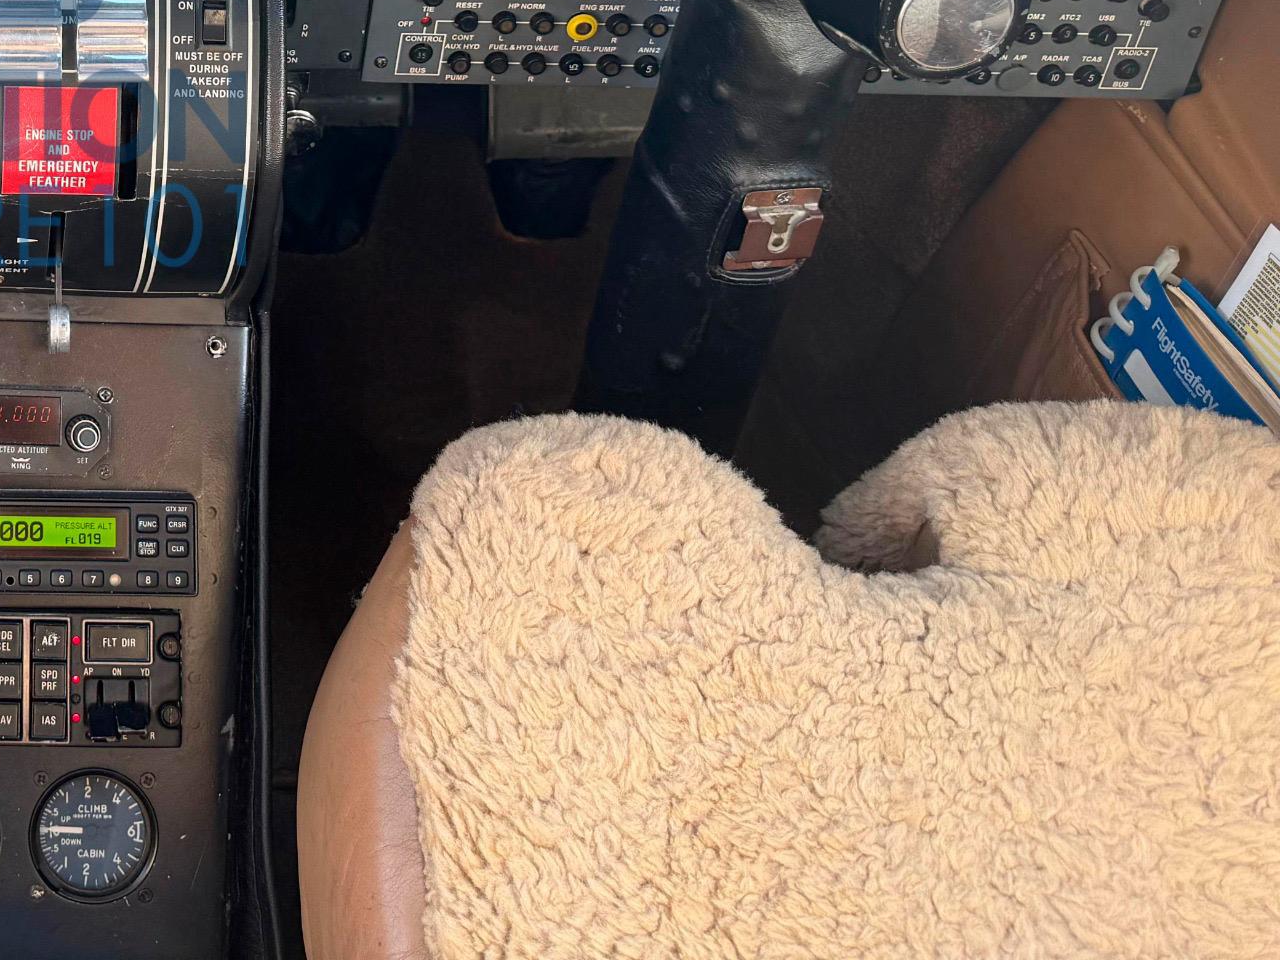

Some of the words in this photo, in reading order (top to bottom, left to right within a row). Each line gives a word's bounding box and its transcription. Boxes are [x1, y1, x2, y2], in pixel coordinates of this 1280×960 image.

[178, 2, 193, 10] ON
[173, 35, 193, 45] OFF
[175, 52, 204, 61] MUST
[207, 52, 220, 61] BE
[223, 52, 243, 61] OFF
[190, 65, 229, 73] DURING
[187, 77, 231, 86] TAKEOFF
[174, 89, 195, 98] AND
[199, 89, 244, 99] LANDING
[26, 130, 62, 140] ENGINE
[67, 130, 94, 141] STOP
[48, 145, 69, 155] AND
[19, 160, 98, 173] EMERGENCY
[29, 176, 86, 188] FEATHER
[1152, 316, 1219, 411] FlightSafety
[18, 446, 49, 454] ALTITUDE
[11, 462, 31, 470] KING
[55, 521, 95, 530] PRESSURE
[98, 522, 112, 530] ALT
[103, 638, 118, 647] FLT
[121, 638, 136, 647] DIR
[42, 715, 56, 725] IAS
[78, 804, 107, 813] CLIMB
[77, 850, 105, 858] CABIN
